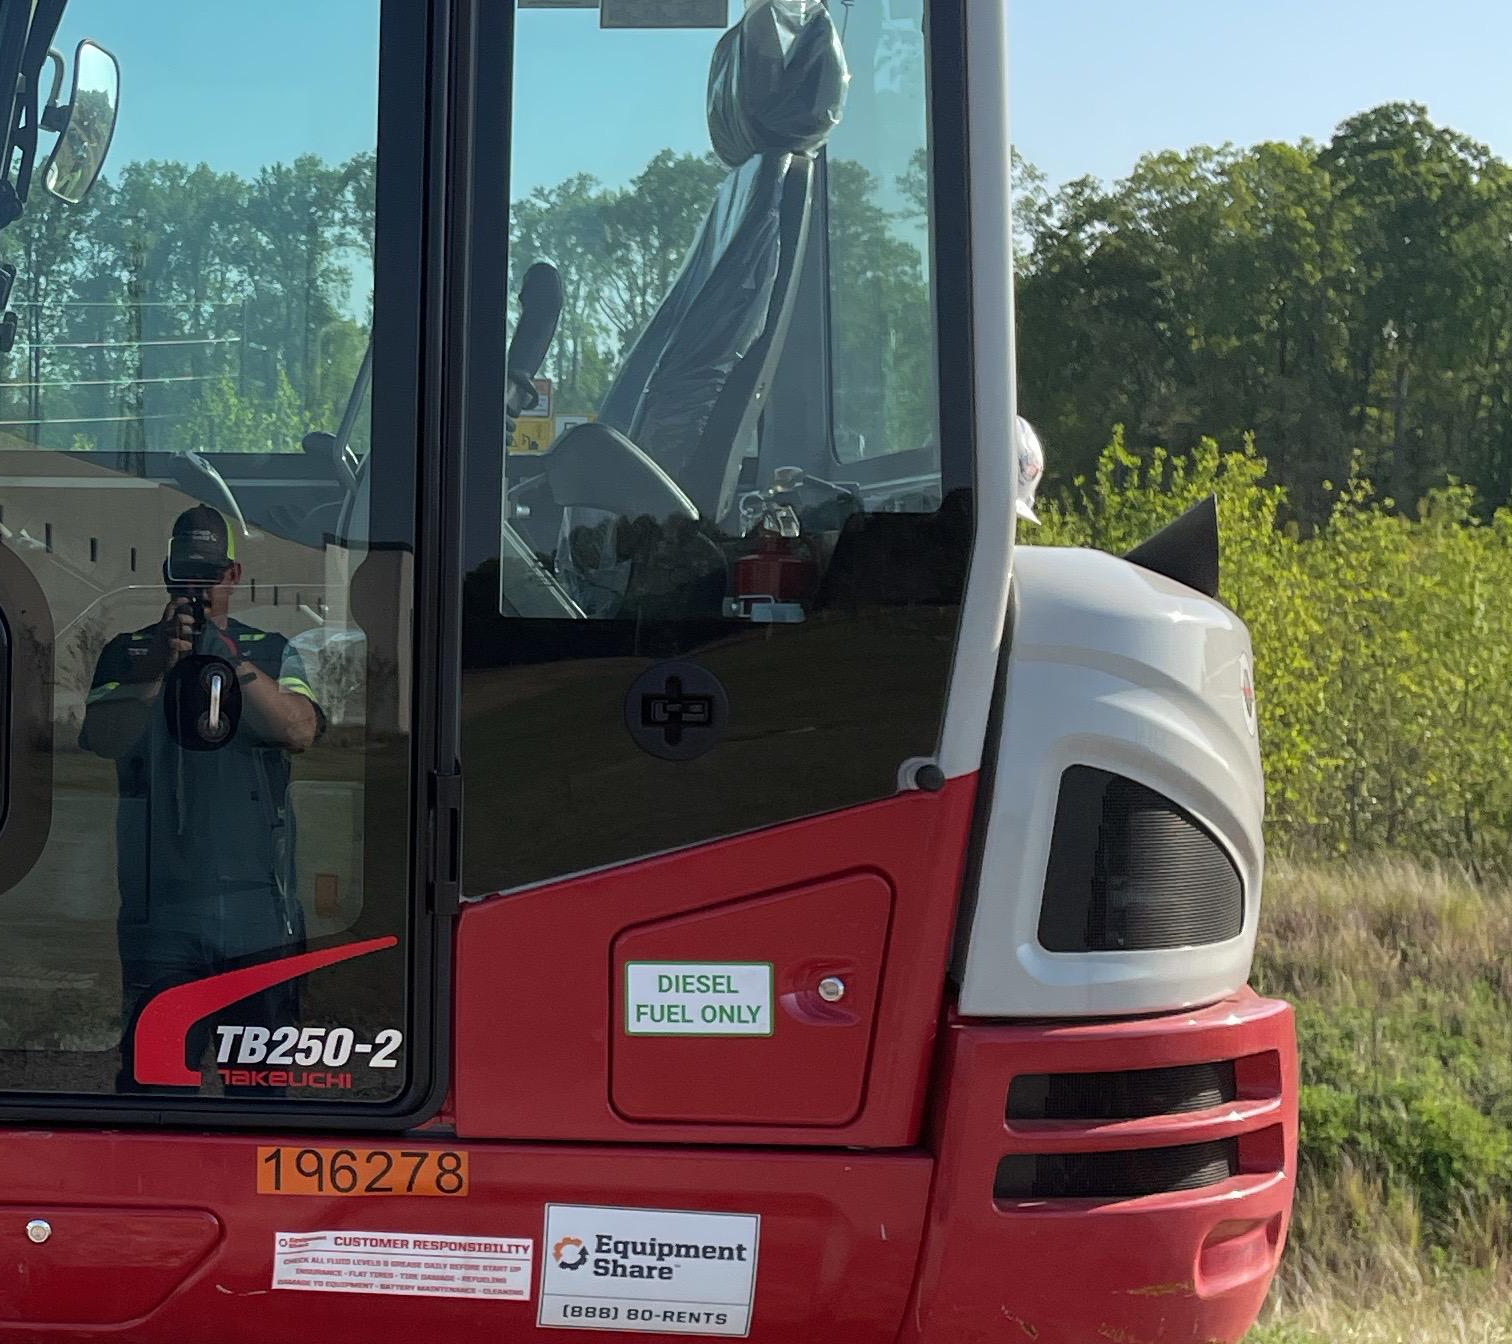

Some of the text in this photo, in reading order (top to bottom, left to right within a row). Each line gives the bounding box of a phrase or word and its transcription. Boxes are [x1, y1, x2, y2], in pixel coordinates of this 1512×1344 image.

[657, 974, 739, 994] DIESEL
[635, 1004, 762, 1024] FUEL ONLY
[216, 1025, 403, 1069] TB250-2
[263, 1148, 464, 1194] 196278
[333, 1236, 409, 1249] CUSTOMER
[413, 1239, 531, 1254] RESPONSIBILITY
[594, 1234, 748, 1262] Equipment
[593, 1258, 674, 1281] Share
[562, 1303, 728, 1325] (888) 80-RENTS
